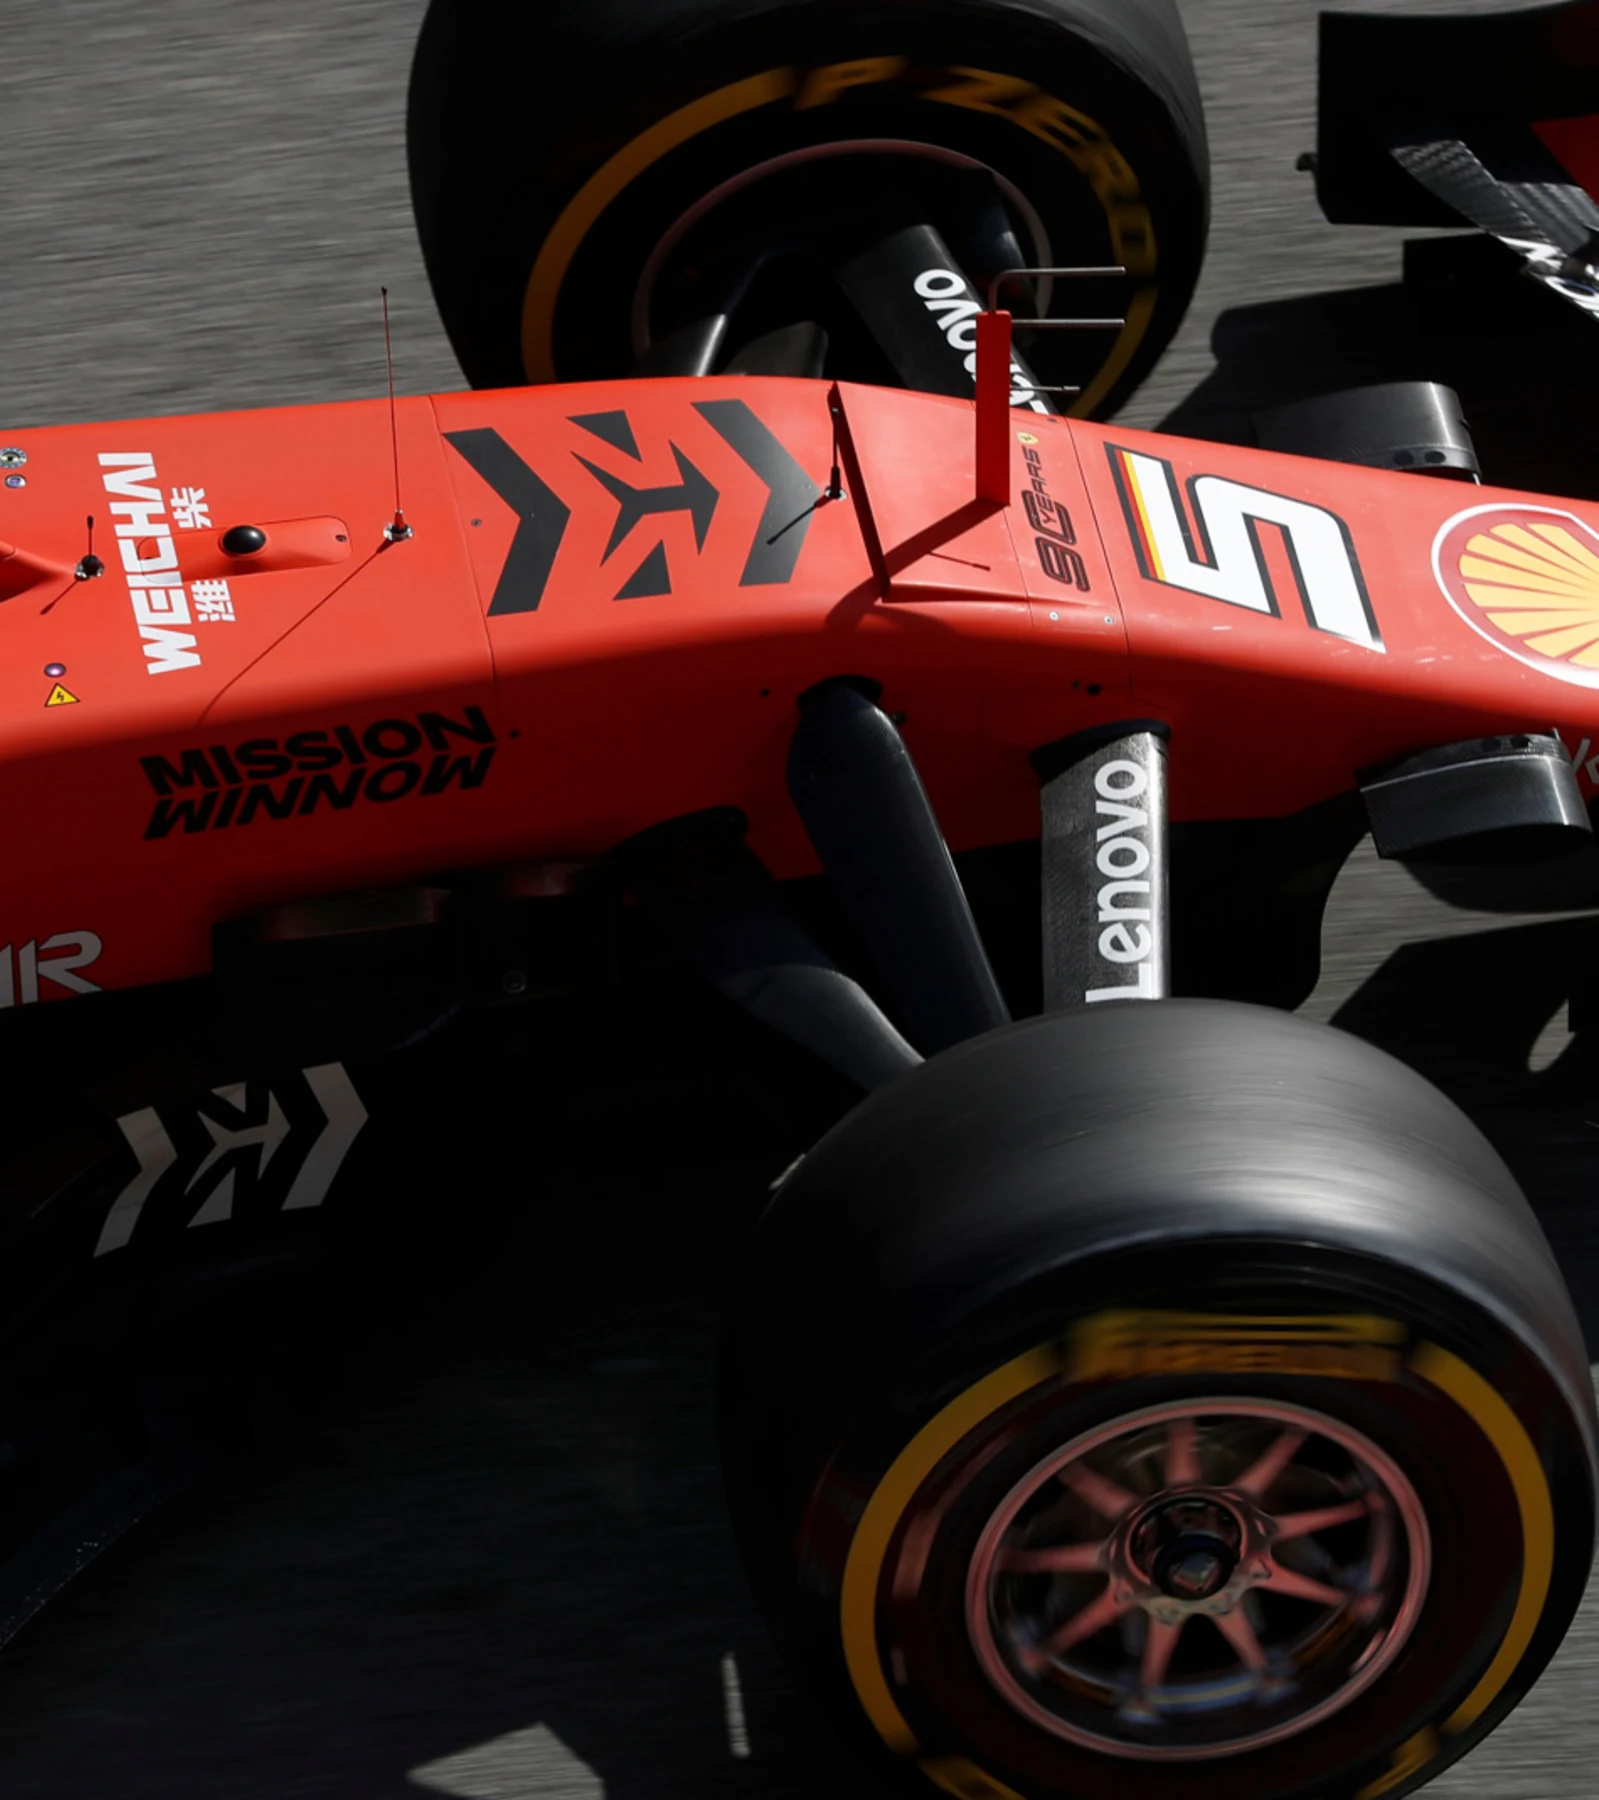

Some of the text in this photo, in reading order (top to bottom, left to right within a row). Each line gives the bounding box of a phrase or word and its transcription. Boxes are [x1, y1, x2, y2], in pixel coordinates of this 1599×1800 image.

[97, 452, 201, 675] WEICHAI
[1104, 441, 1386, 654] 5
[139, 705, 497, 797] MISSION
[142, 746, 497, 841] WINNOW
[1085, 759, 1152, 1003] Lenovo
